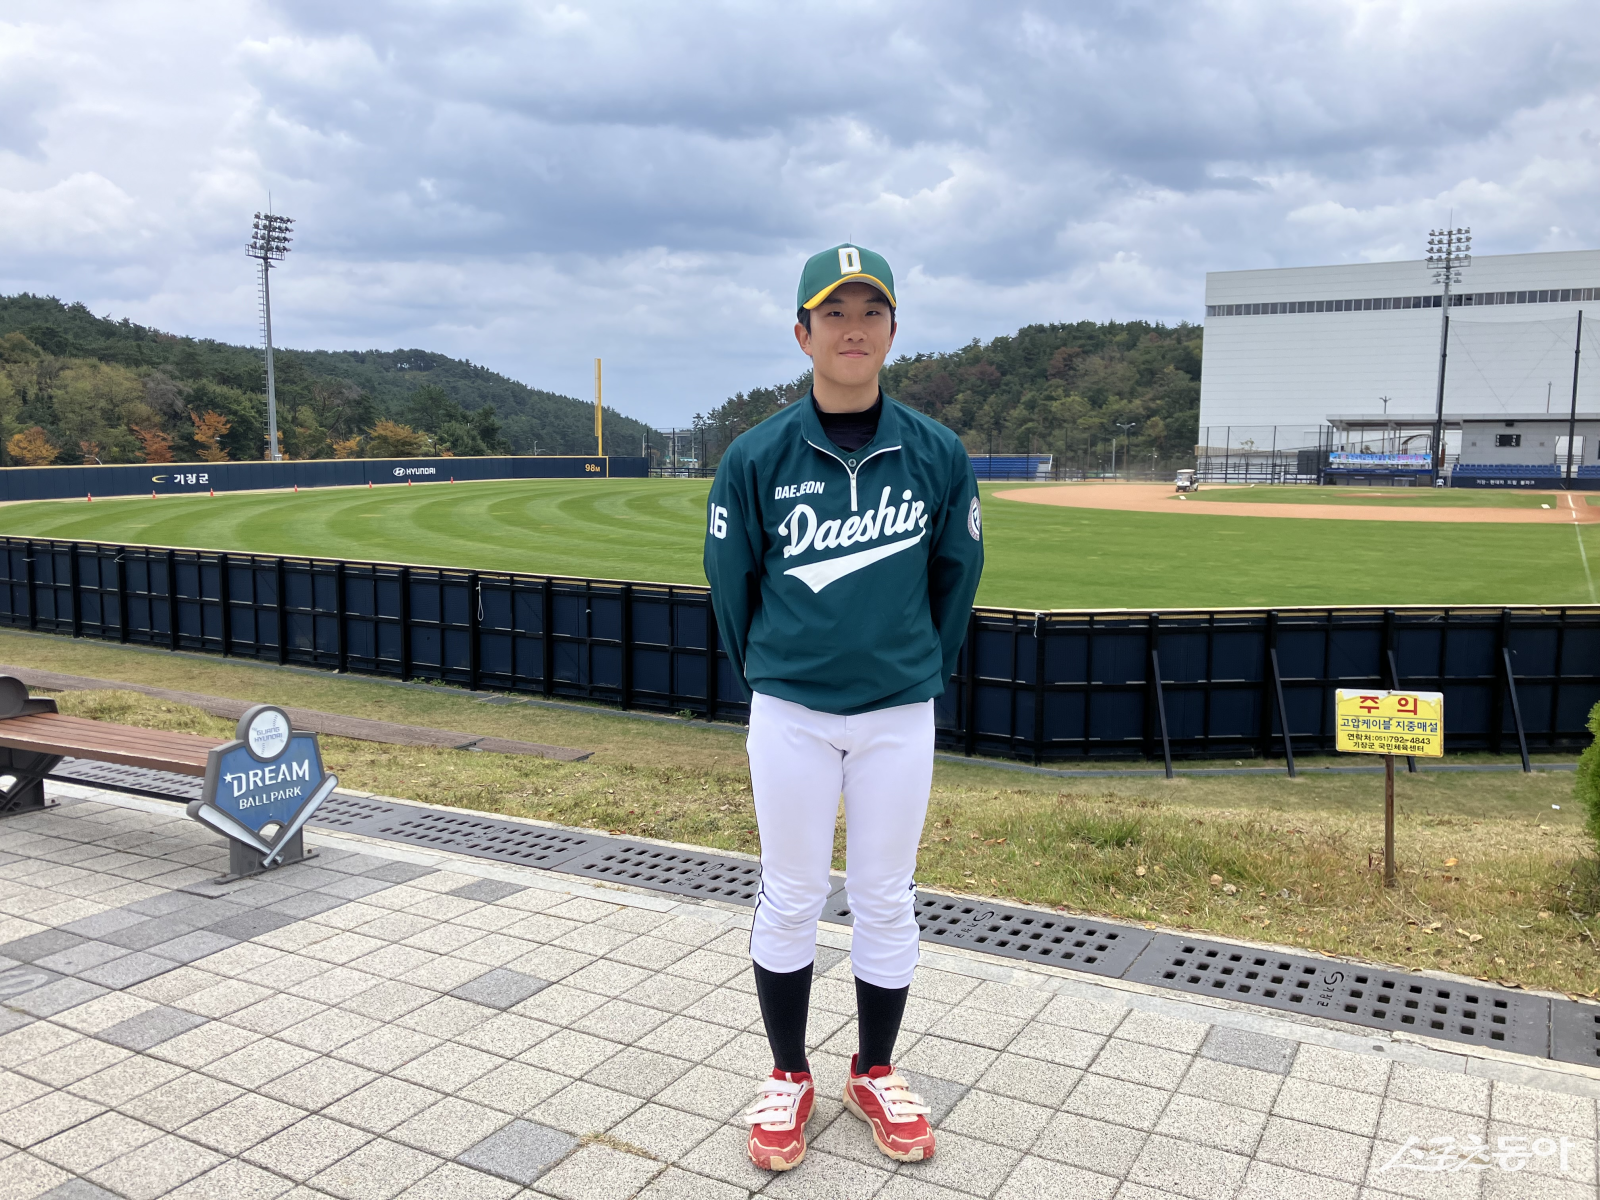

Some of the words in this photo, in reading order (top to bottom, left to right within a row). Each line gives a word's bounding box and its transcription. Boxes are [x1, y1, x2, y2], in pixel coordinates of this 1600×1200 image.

[838, 247, 862, 275] D
[173, 473, 209, 484] 기장군
[406, 467, 436, 475] HYUNDAI
[709, 502, 728, 540] 16
[777, 486, 928, 559] Daeshin
[1340, 718, 1393, 731] 고압케이블
[1395, 720, 1438, 733] 지중매설
[254, 733, 282, 742] HYUNDAI
[1353, 742, 1376, 750] 기장군
[1378, 743, 1424, 753] 국민체육센터
[232, 759, 309, 797] DREAM
[239, 786, 302, 810] BALLPARK
